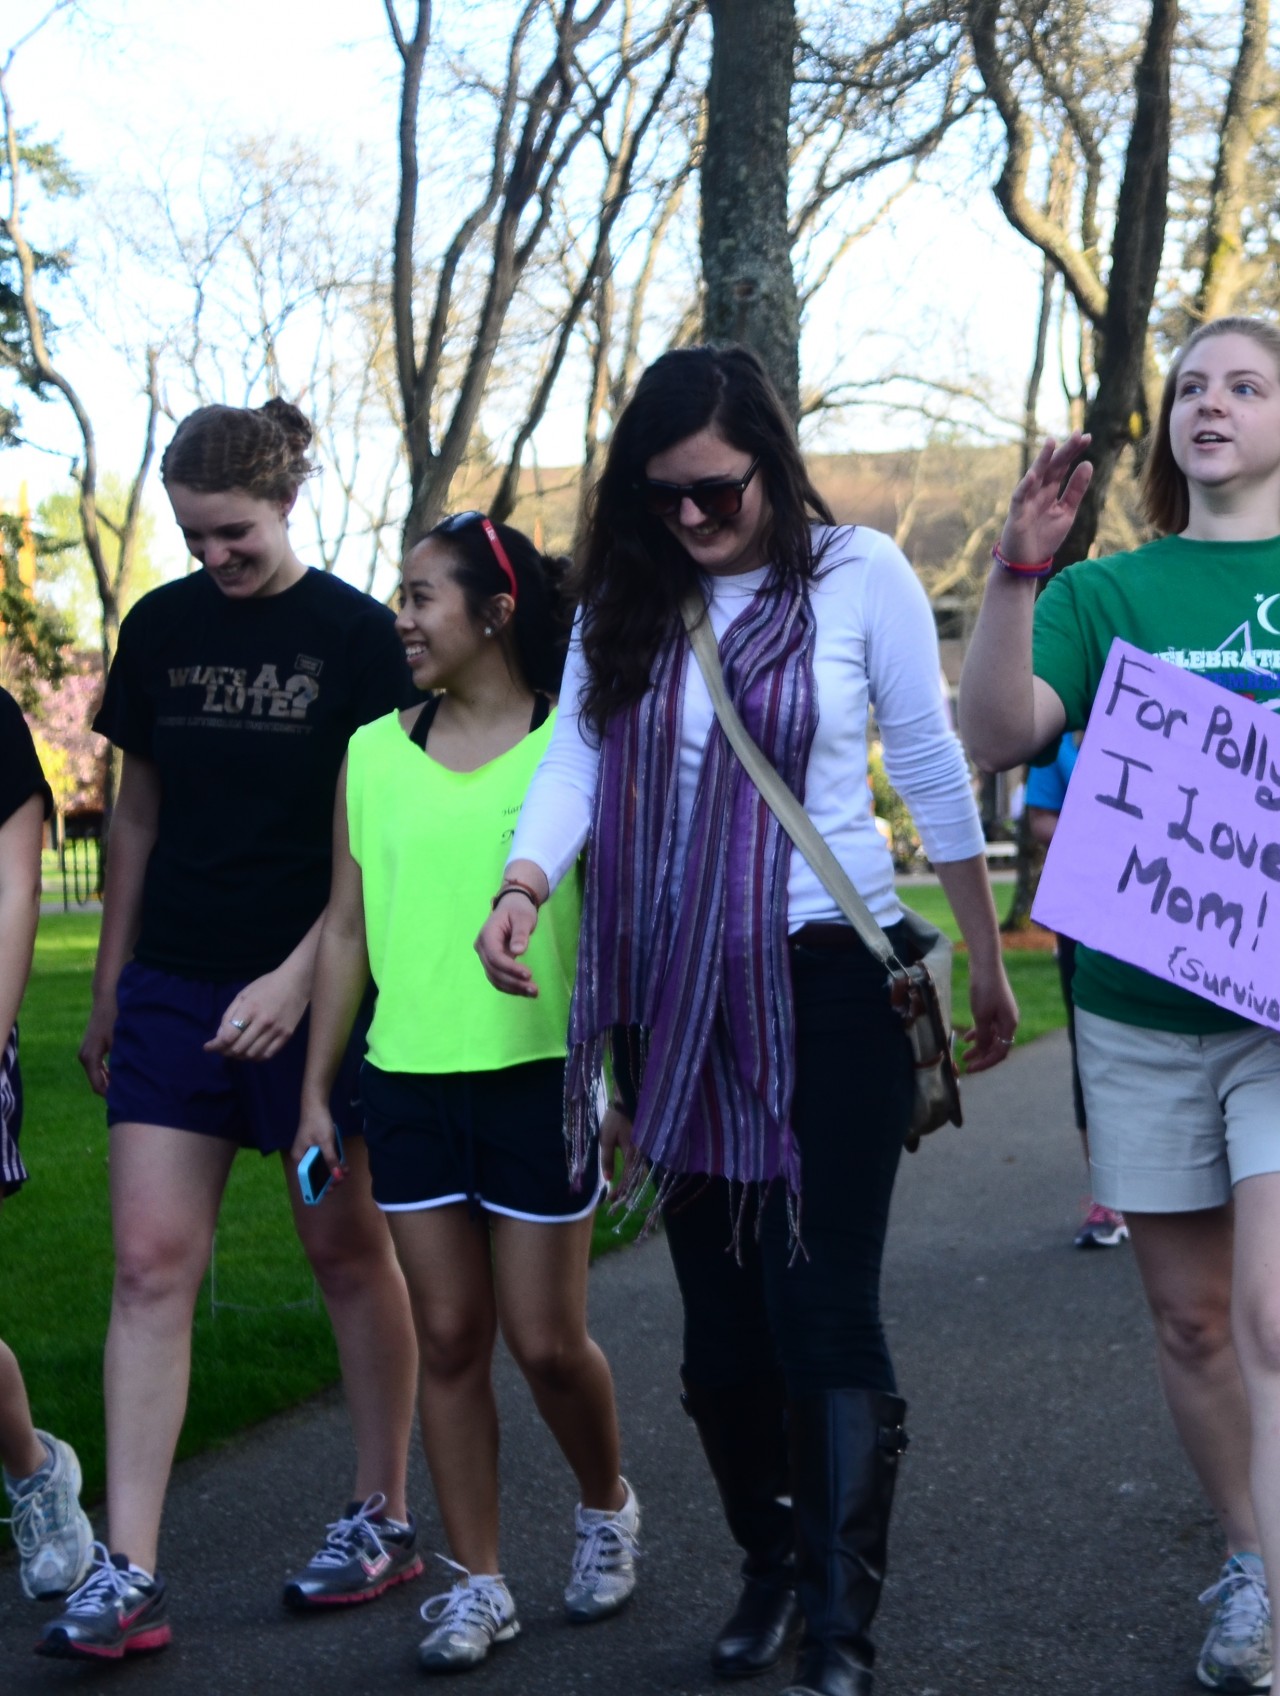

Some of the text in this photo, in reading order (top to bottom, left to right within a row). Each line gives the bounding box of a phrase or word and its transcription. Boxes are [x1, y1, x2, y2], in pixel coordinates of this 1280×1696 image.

[168, 665, 247, 688] WHAT'S
[252, 663, 279, 690] A
[202, 674, 320, 719] LUTE?
[1105, 654, 1188, 738] For
[1095, 749, 1153, 819] I
[1117, 844, 1268, 952] Mom!
